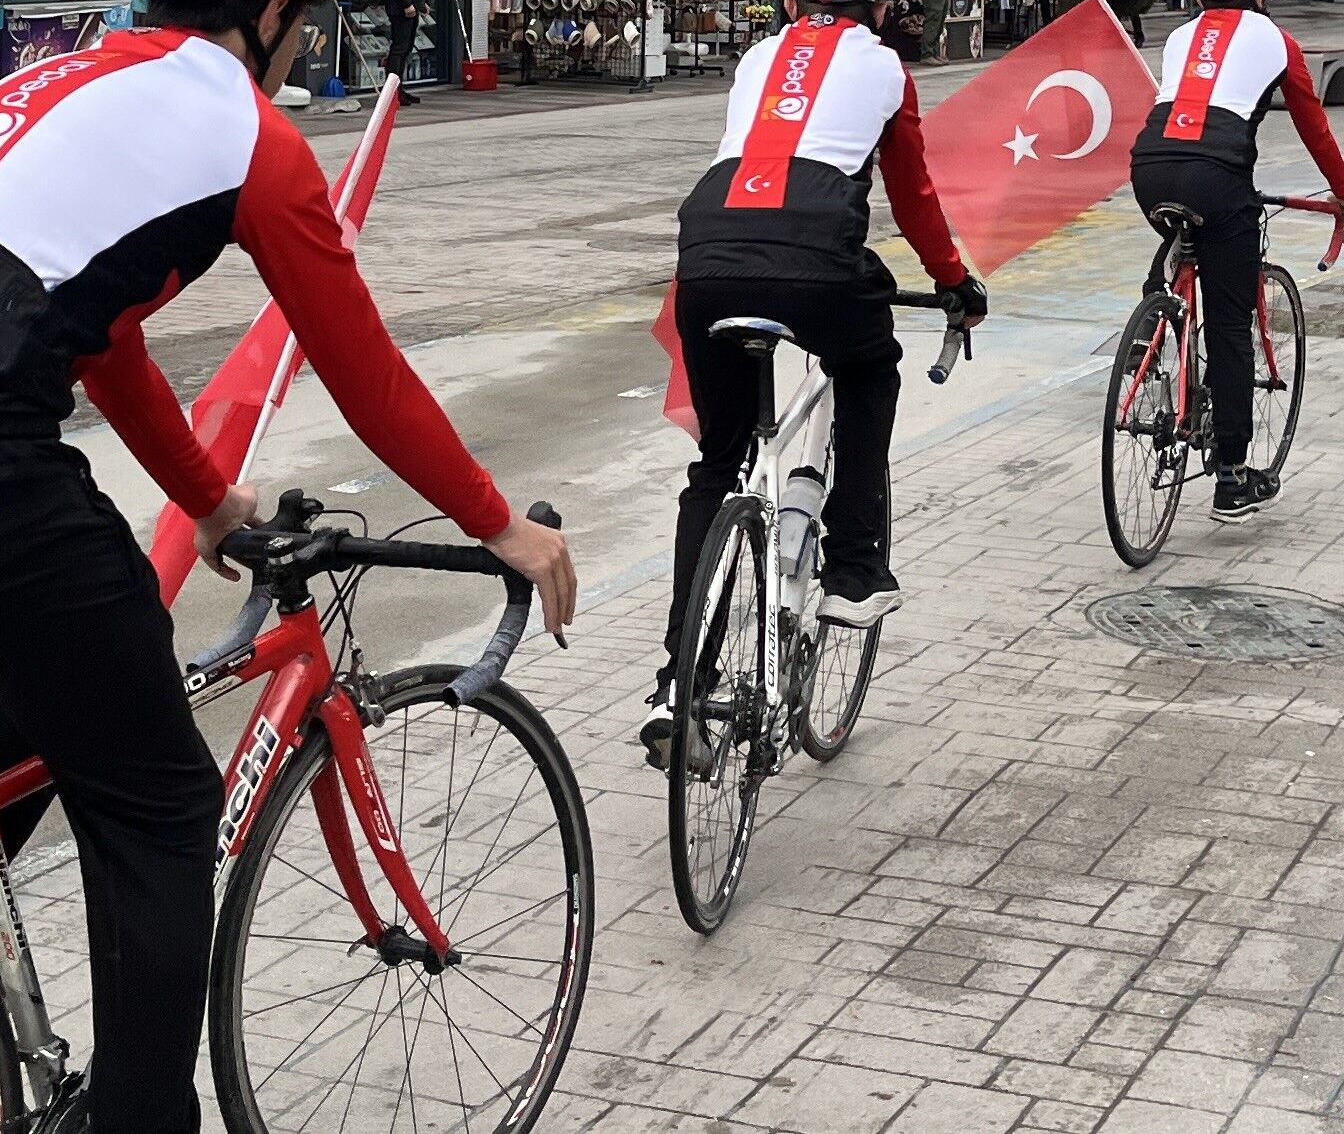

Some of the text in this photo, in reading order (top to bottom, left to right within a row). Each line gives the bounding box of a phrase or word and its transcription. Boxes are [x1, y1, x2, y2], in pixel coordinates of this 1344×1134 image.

[1198, 29, 1221, 61] pedal
[1, 58, 98, 109] pedal
[782, 46, 815, 94] pedal
